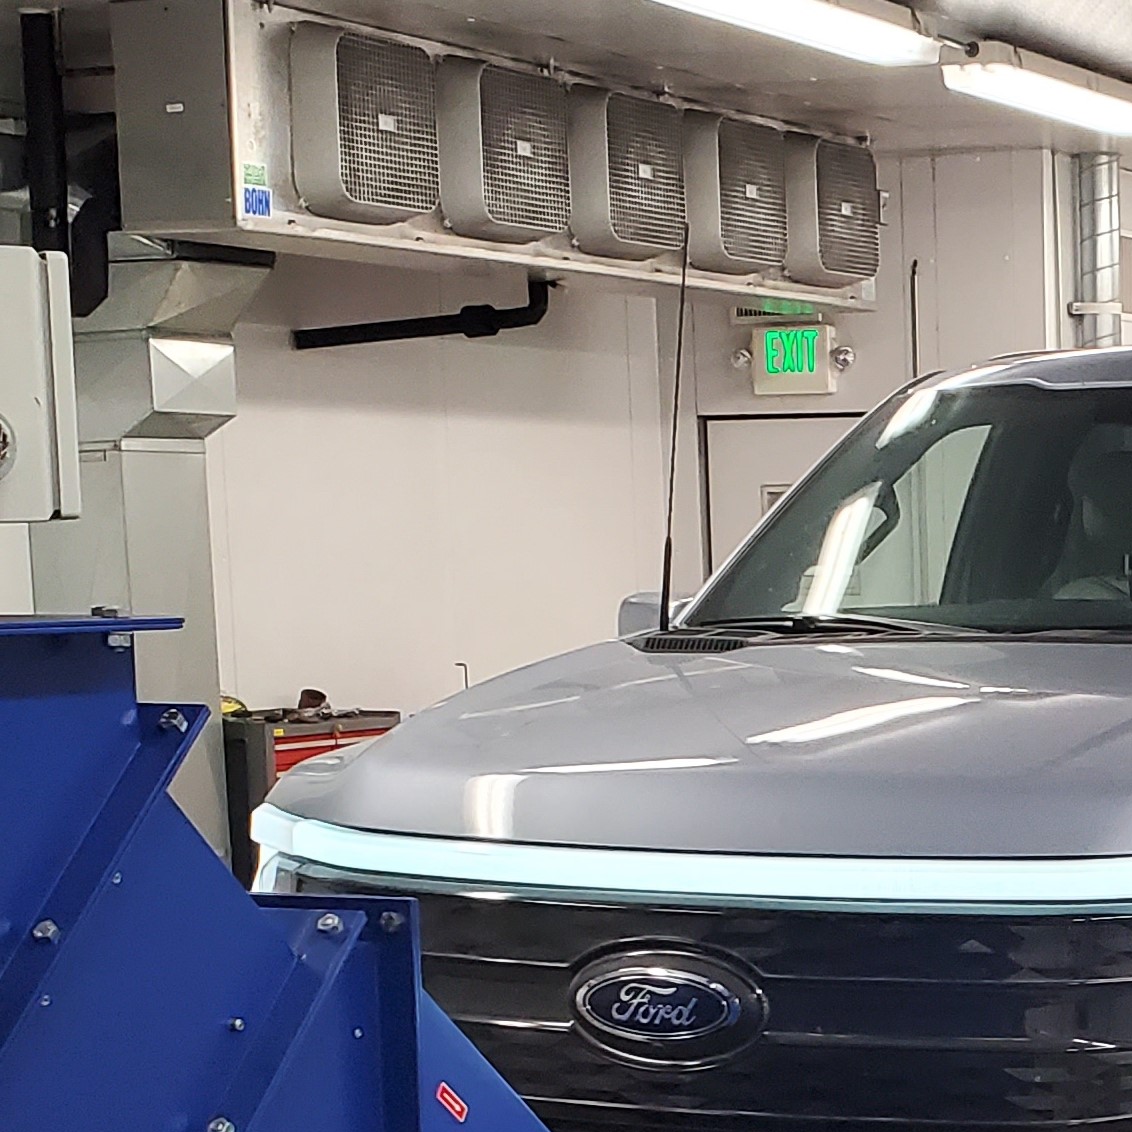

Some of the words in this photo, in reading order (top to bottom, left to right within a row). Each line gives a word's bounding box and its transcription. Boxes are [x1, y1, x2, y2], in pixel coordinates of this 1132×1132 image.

[244, 187, 270, 217] BOHN
[766, 330, 818, 373] EXIT
[611, 982, 698, 1026] Ford
